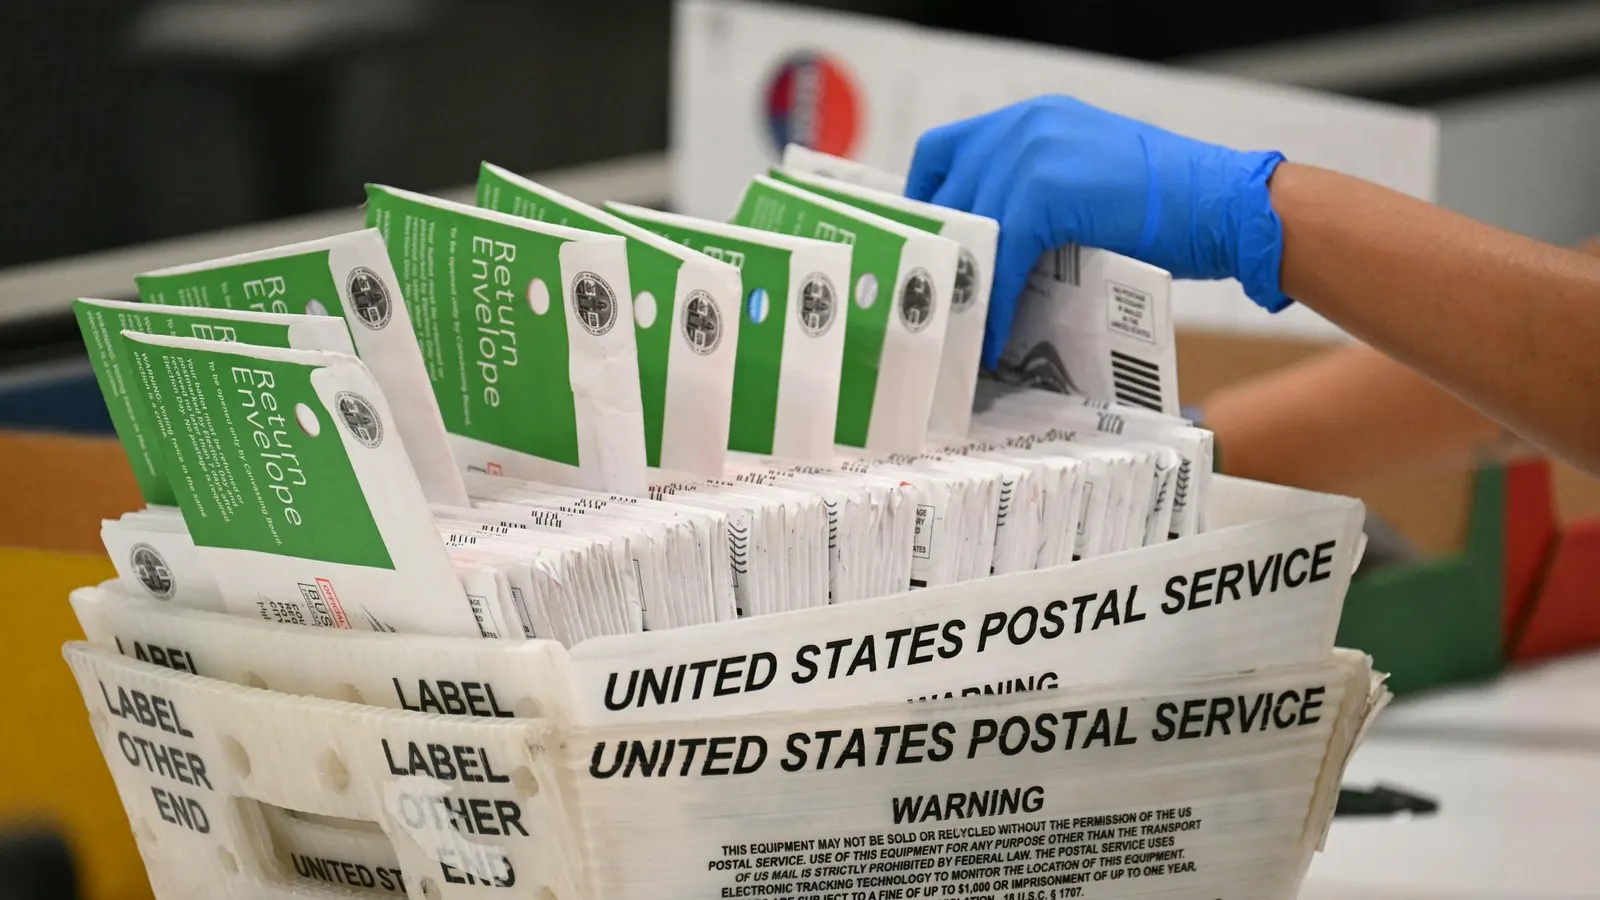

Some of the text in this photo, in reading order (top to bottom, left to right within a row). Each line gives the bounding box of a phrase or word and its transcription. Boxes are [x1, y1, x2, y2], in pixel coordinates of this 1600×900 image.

[472, 236, 500, 407] Envelope
[494, 240, 518, 366] Return
[133, 351, 151, 390] election
[147, 392, 154, 400] is
[151, 401, 157, 409] a
[141, 352, 207, 518] WARNING: Voting twice in the same
[162, 355, 179, 394] Election
[183, 418, 193, 432] No
[188, 434, 208, 472] postage
[205, 473, 211, 482] is
[170, 355, 189, 397] received
[184, 398, 192, 412] no
[189, 413, 201, 436] later
[198, 438, 210, 460] than
[210, 469, 223, 492] days
[220, 493, 234, 515] after
[176, 356, 239, 507] postmarked by Election Day and
[186, 358, 244, 504] Your ballot must be returned or
[208, 360, 215, 372] To
[212, 373, 220, 386] be
[216, 388, 233, 425] opened
[229, 426, 241, 448] only
[237, 449, 246, 461] by
[243, 463, 269, 515] Canvassing
[253, 369, 307, 486] Return
[231, 366, 302, 526] Envelope
[912, 545, 927, 554] ATES
[284, 603, 299, 625] REG
[291, 603, 307, 626] COU
[308, 589, 332, 627] BUS
[605, 540, 1336, 710] UNITED STATES POSTAL SERVICE
[99, 681, 194, 739] LABEL
[392, 677, 515, 718] LABEL
[589, 686, 1326, 779] UNITED STATES POSTAL SERVICE
[117, 731, 214, 791] OTHER
[381, 738, 510, 783] LABEL
[151, 786, 210, 834] END
[399, 794, 530, 837] OTHER
[721, 806, 1192, 856] THIS EQUIPMENT MAY NOT BE SOLD OR RECYCLED WITHOUT THE PERMISSION OF THE US
[892, 786, 1045, 825] WARNING
[437, 849, 516, 888] END
[708, 819, 1202, 871] POSTAL SERVICE. USE OF THIS EQUIPMENT FOR ANY PURPOSE OTHER THAN THE TRANSPORT
[735, 835, 1175, 883] OF US MAIL IS STRICTLY PROHIBITED BY FEDERAL LAW. THE POSTAL SERVICE USES
[290, 853, 407, 893] UNITED ST
[721, 882, 793, 898] ELECTRONIC
[795, 878, 854, 893] TRACKING
[856, 872, 932, 888] TECHNOLOGY
[933, 870, 949, 882] TO
[951, 866, 1001, 881] MONITOR
[1003, 864, 1025, 876] THE
[1026, 859, 1080, 874] LOCATION
[1081, 857, 1097, 869] OF
[1099, 855, 1122, 867] THIS
[1124, 848, 1185, 865] EQUIPMENT.
[850, 891, 867, 900] TO
[867, 890, 877, 900] A
[878, 888, 904, 900] FINE
[905, 887, 921, 899] OF
[923, 885, 939, 897] UP
[940, 884, 956, 896] TO
[957, 881, 991, 895] $1,000
[992, 879, 1009, 891] OR
[1011, 871, 1092, 889] IMPRISONMENT
[1092, 870, 1108, 882] OF
[1110, 868, 1125, 880] UP
[1126, 866, 1141, 878] TO
[1142, 864, 1165, 877] ONE
[1167, 861, 1197, 874] YEAR,
[1003, 892, 1016, 900] 18
[1059, 886, 1085, 899] 1707.
